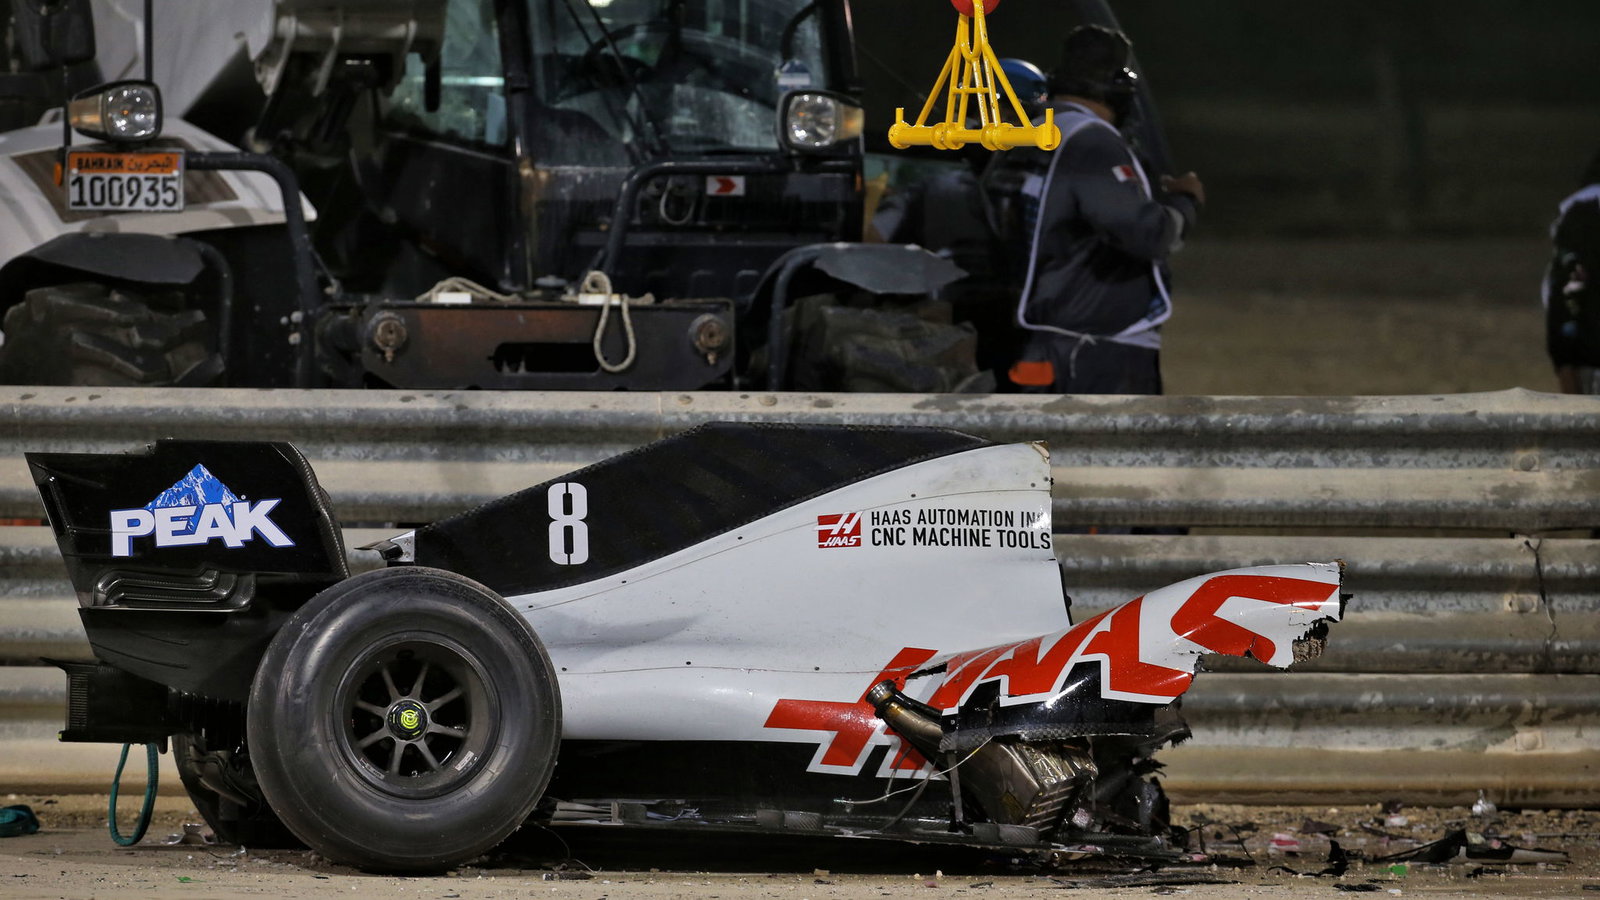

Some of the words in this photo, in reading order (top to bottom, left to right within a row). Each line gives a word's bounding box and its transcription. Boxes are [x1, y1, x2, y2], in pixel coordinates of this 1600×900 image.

[77, 157, 124, 170] BAHRAIN
[127, 156, 174, 172] البحرين
[71, 175, 178, 208] 100935
[109, 498, 296, 557] PEAK
[547, 482, 589, 565] 8
[871, 510, 911, 526] HAAS
[917, 508, 1014, 527] AUTOMATION
[818, 536, 862, 547] HAAS
[871, 527, 907, 547] CNC
[912, 527, 991, 547] MACHINE
[996, 529, 1051, 550] TOOLS
